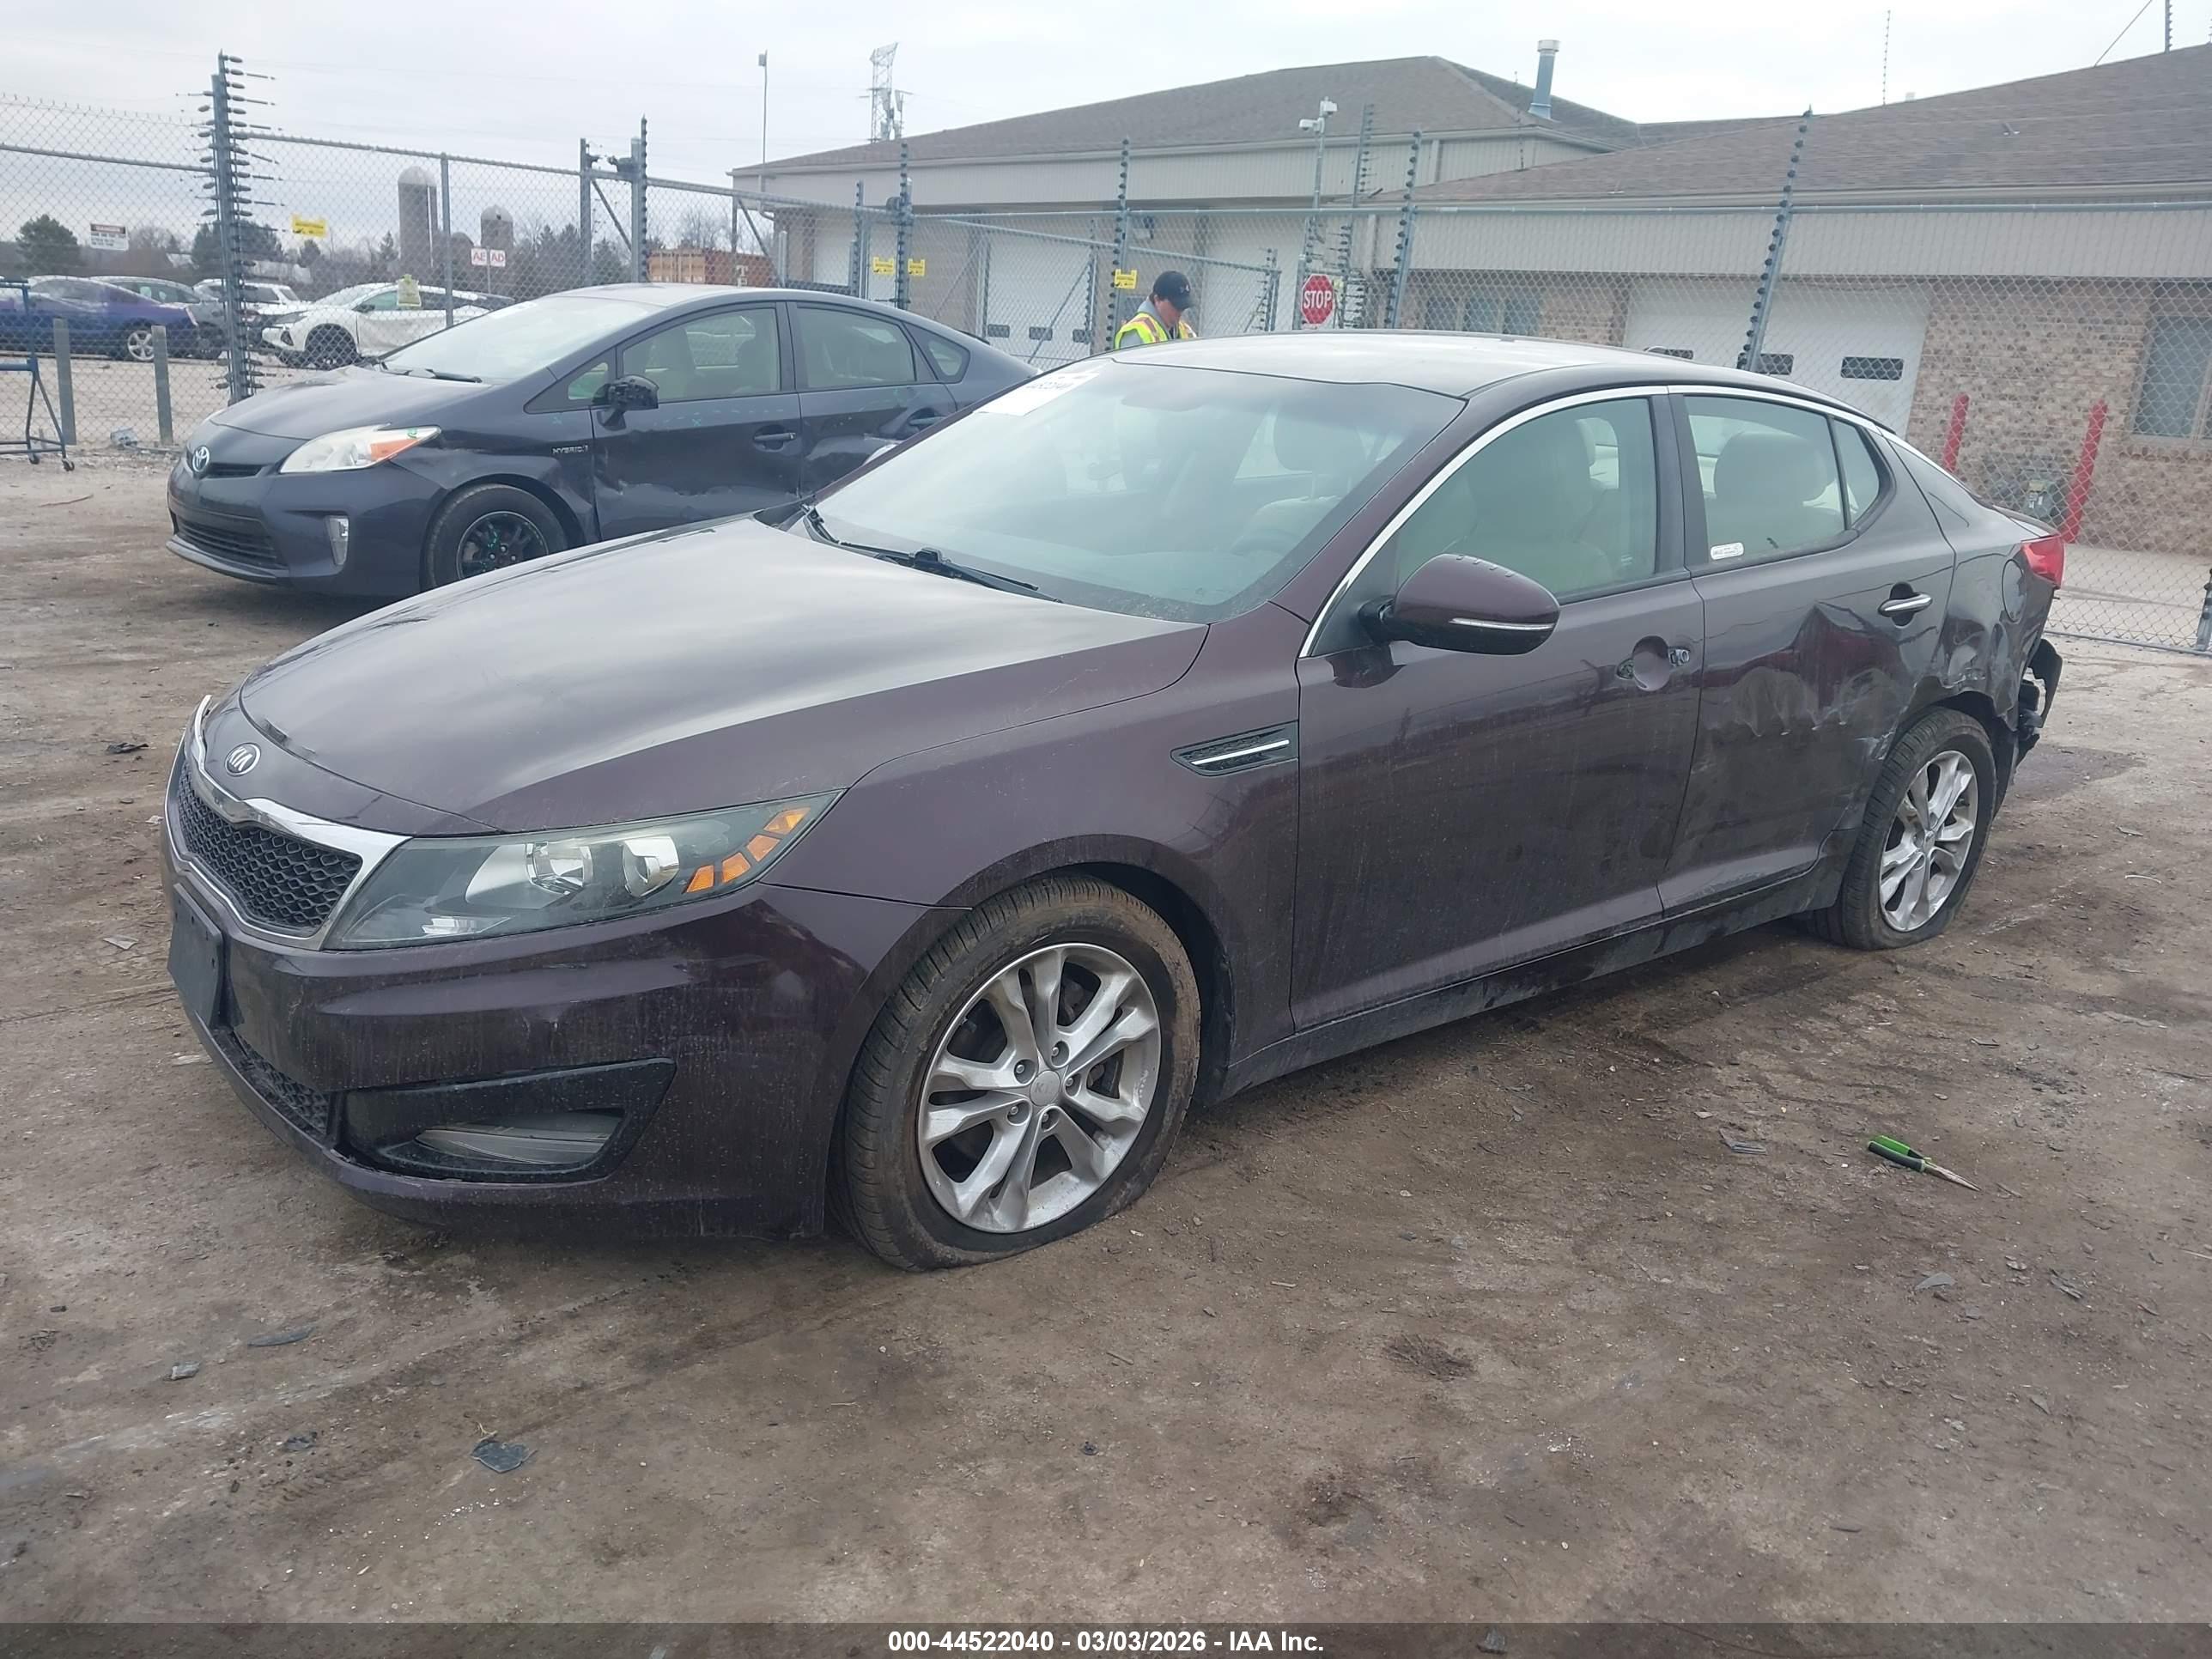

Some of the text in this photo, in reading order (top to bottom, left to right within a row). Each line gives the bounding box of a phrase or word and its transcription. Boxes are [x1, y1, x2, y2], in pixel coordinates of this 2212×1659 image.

[491, 253, 505, 262] AD
[1303, 290, 1332, 309] STOP
[228, 746, 253, 772] KIA
